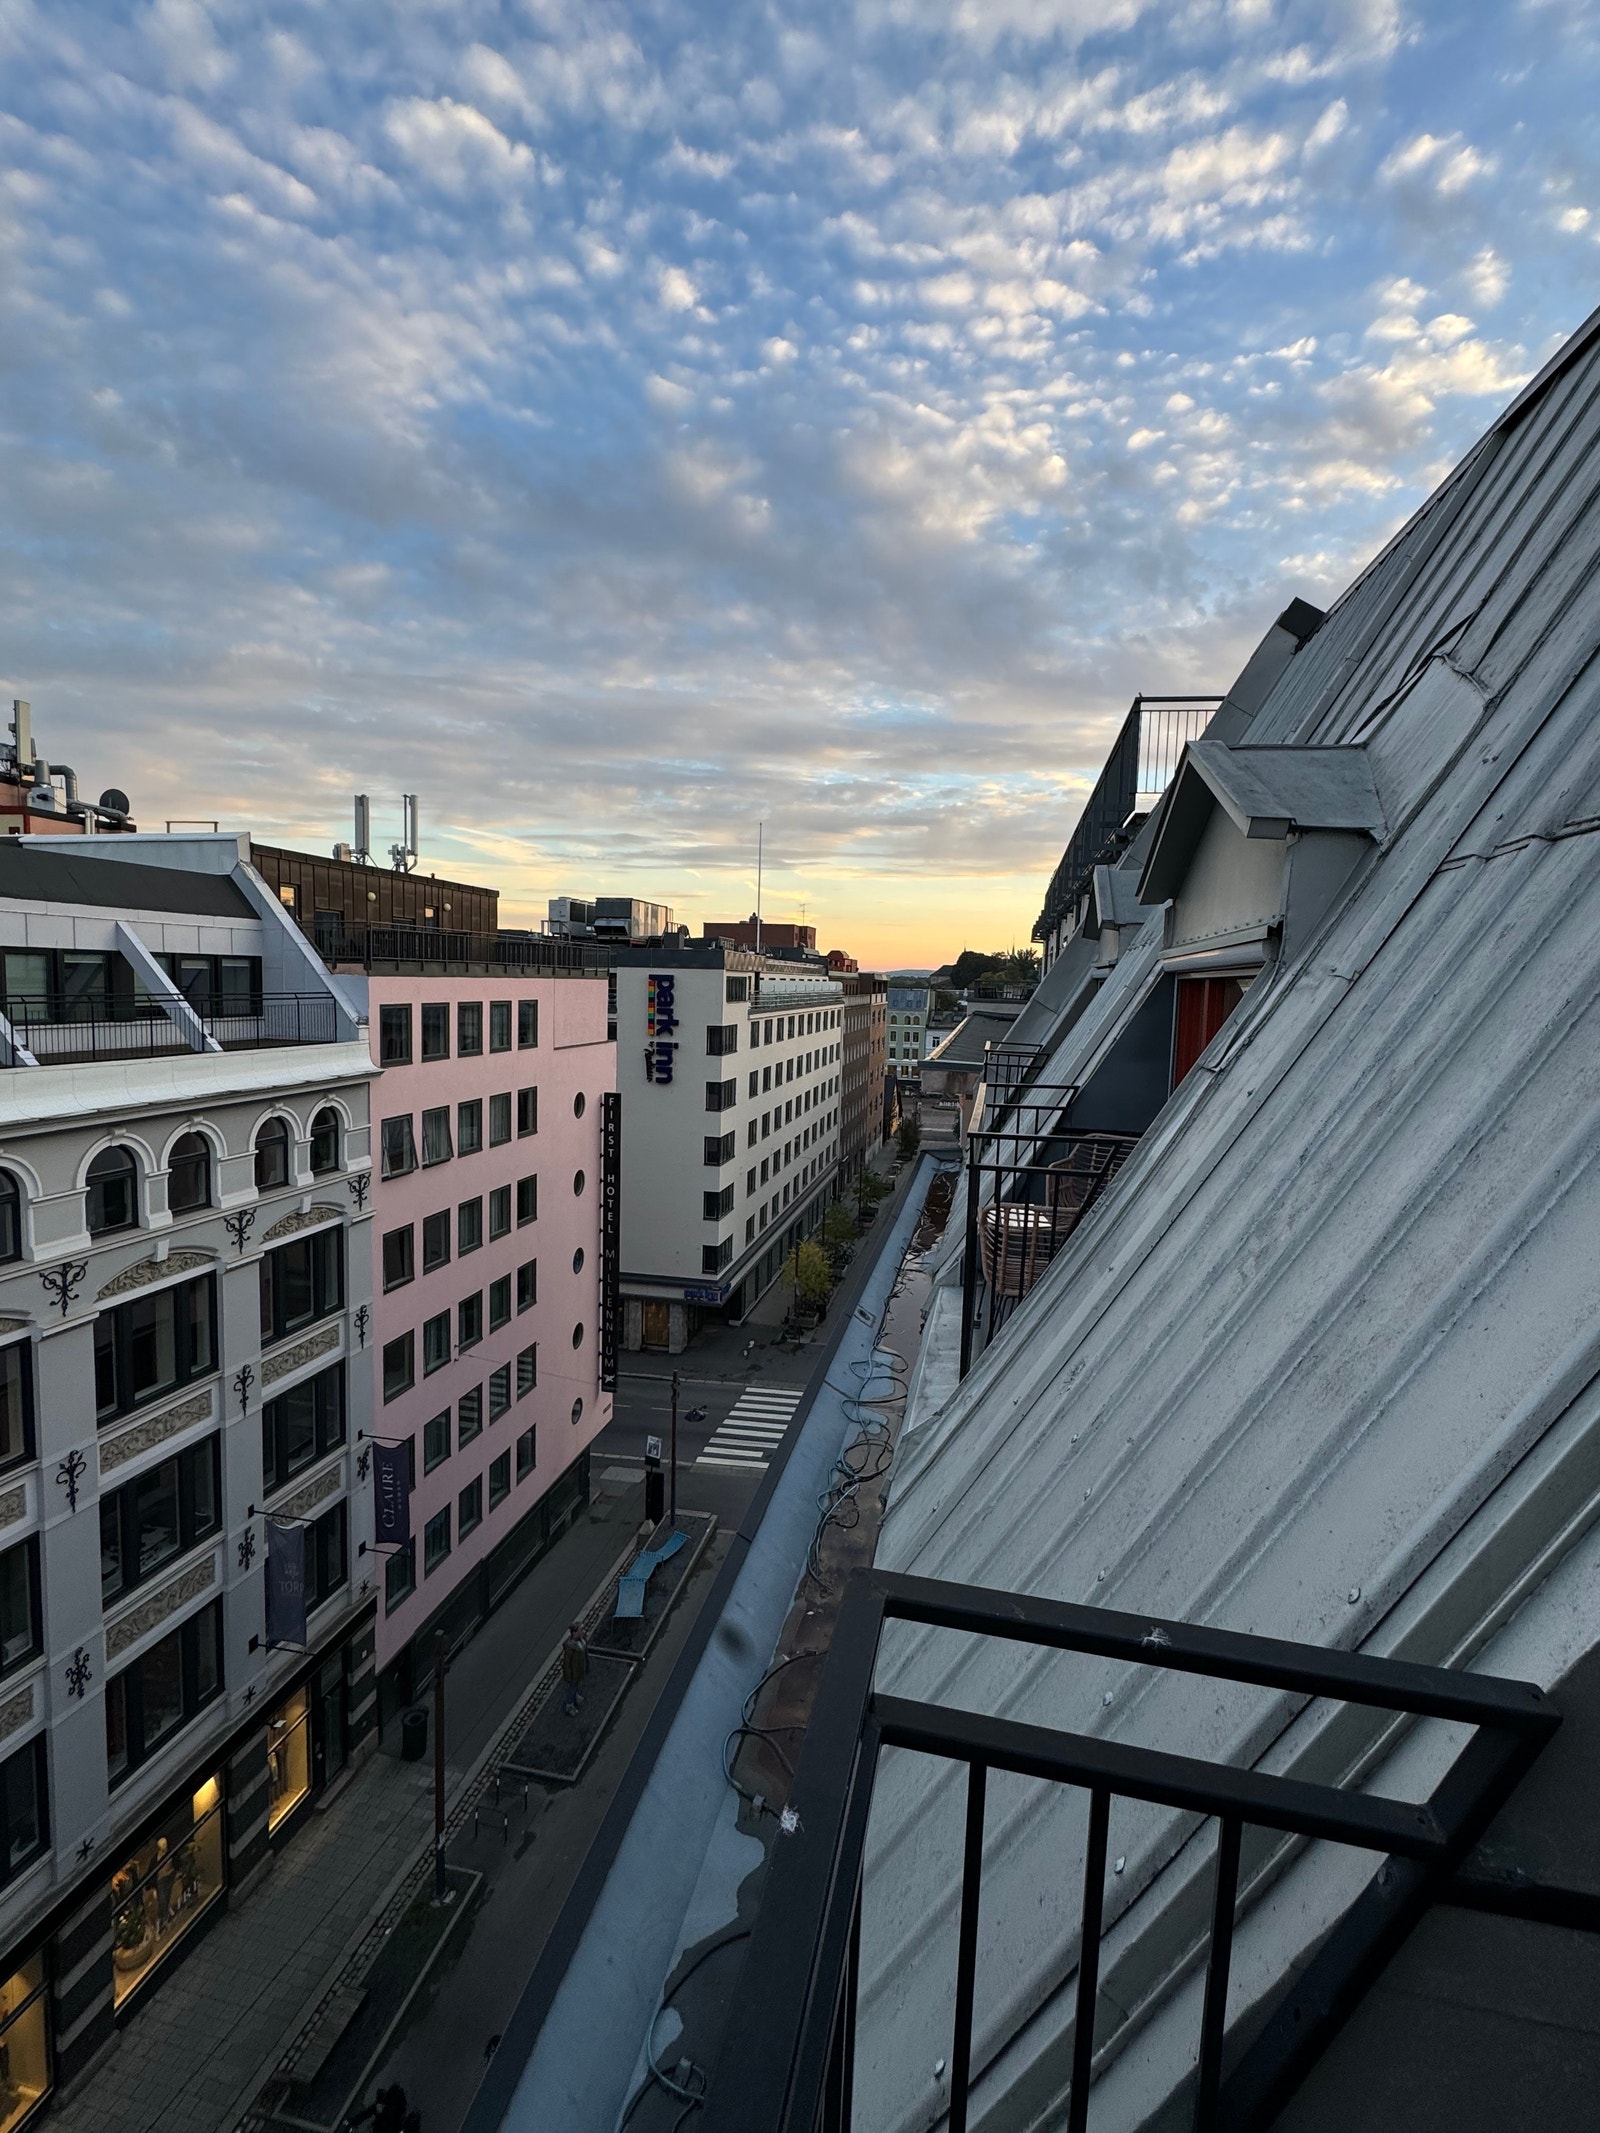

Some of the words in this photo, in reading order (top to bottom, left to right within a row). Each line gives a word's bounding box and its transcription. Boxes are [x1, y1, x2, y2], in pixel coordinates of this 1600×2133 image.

[648, 974, 679, 1036] park
[655, 1042, 679, 1084] inn
[606, 1174, 615, 1234] HOTEL
[604, 1249, 615, 1368] MILLENNIUM
[382, 1462, 395, 1527] CLAIRE
